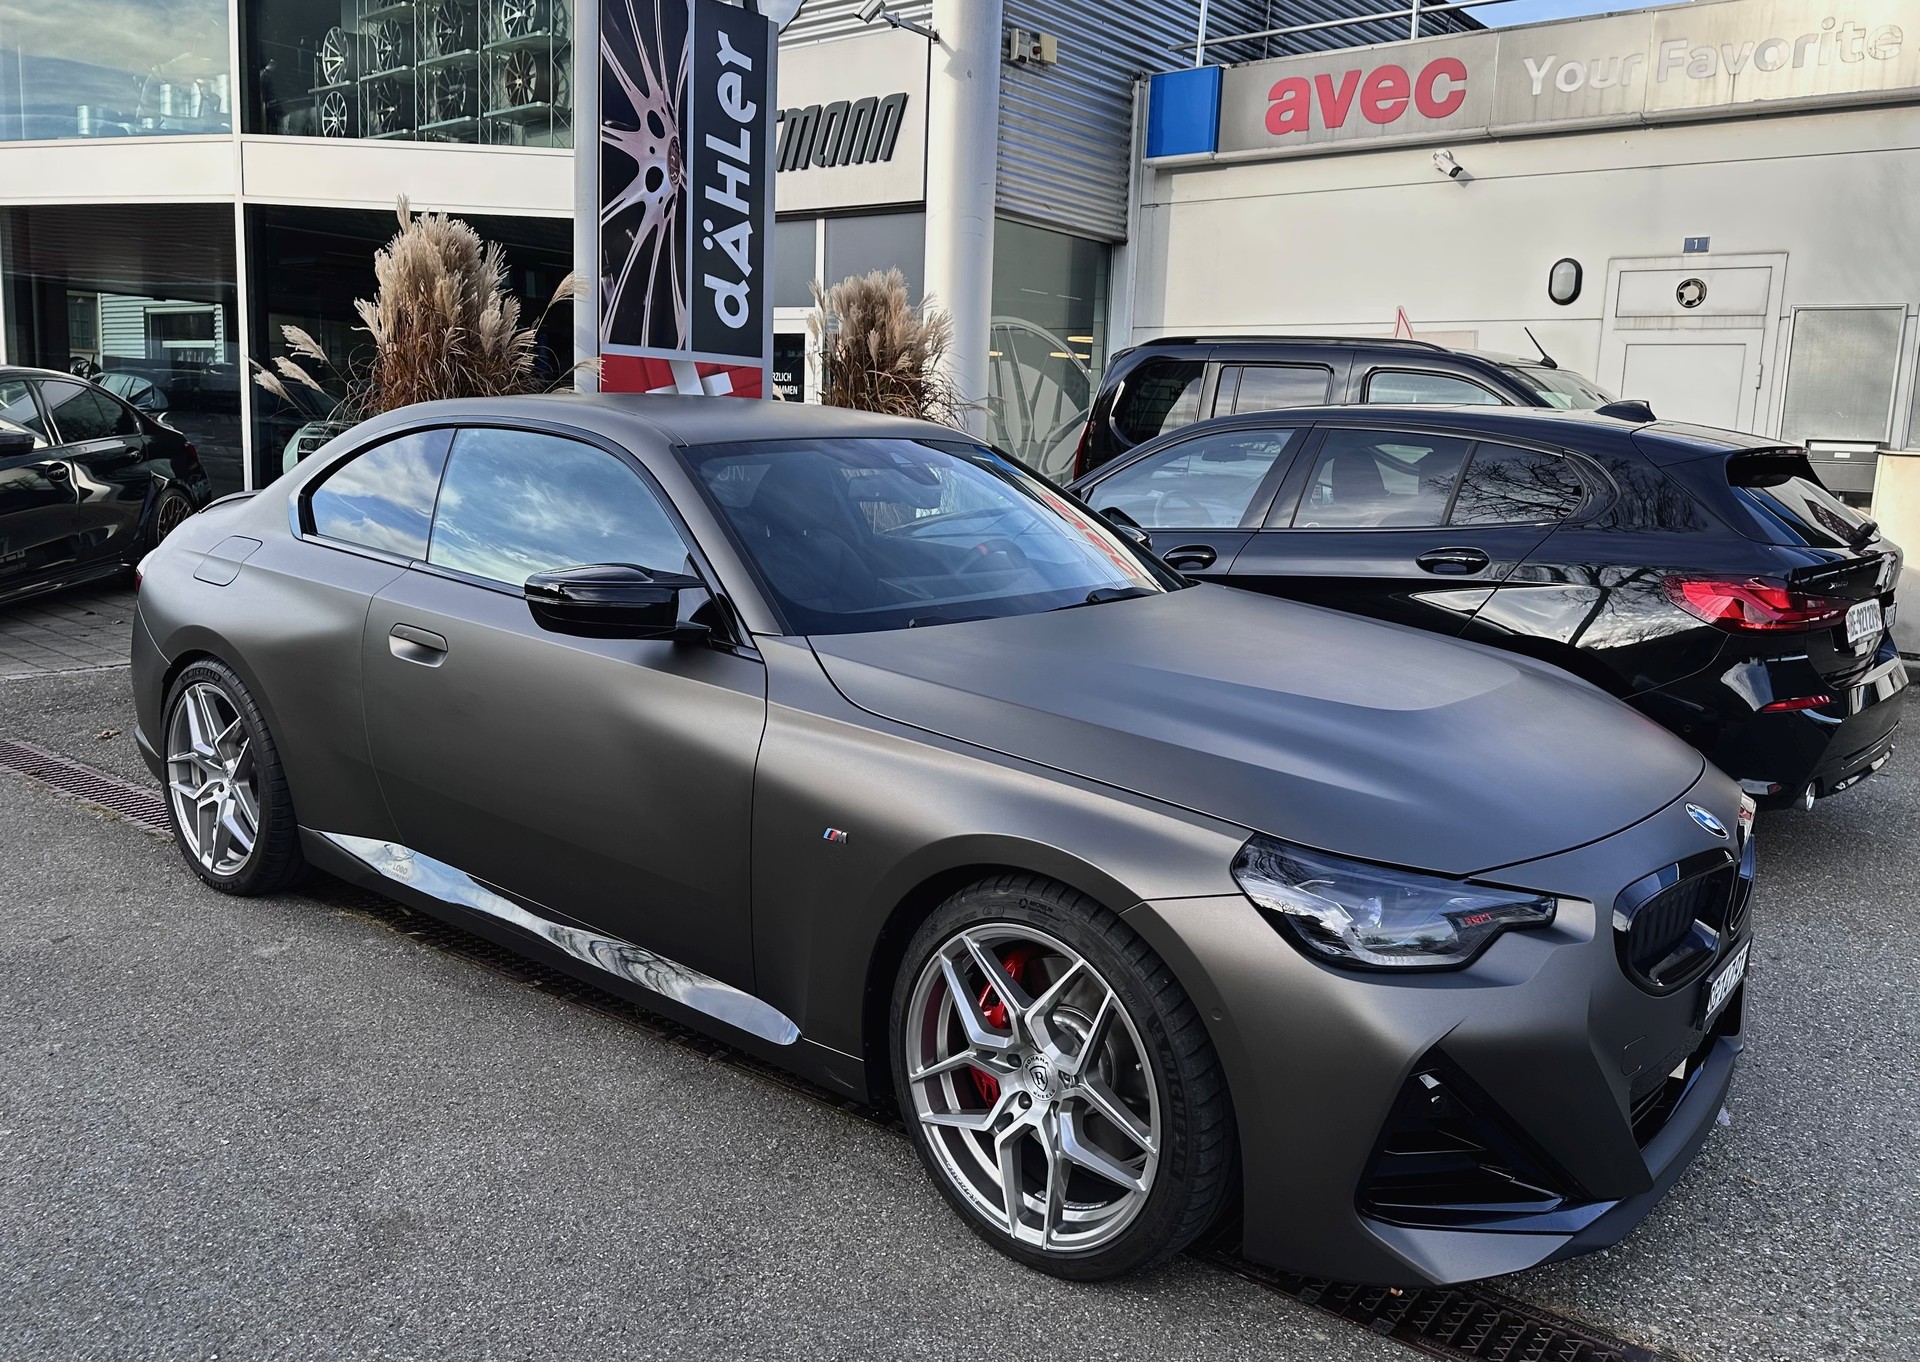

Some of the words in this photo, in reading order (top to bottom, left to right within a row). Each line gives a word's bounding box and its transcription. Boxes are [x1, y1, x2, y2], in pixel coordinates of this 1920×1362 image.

[1264, 56, 1468, 135] avec
[1523, 52, 1644, 96] Your
[1657, 16, 1904, 83] Favorite
[776, 92, 909, 172] mann
